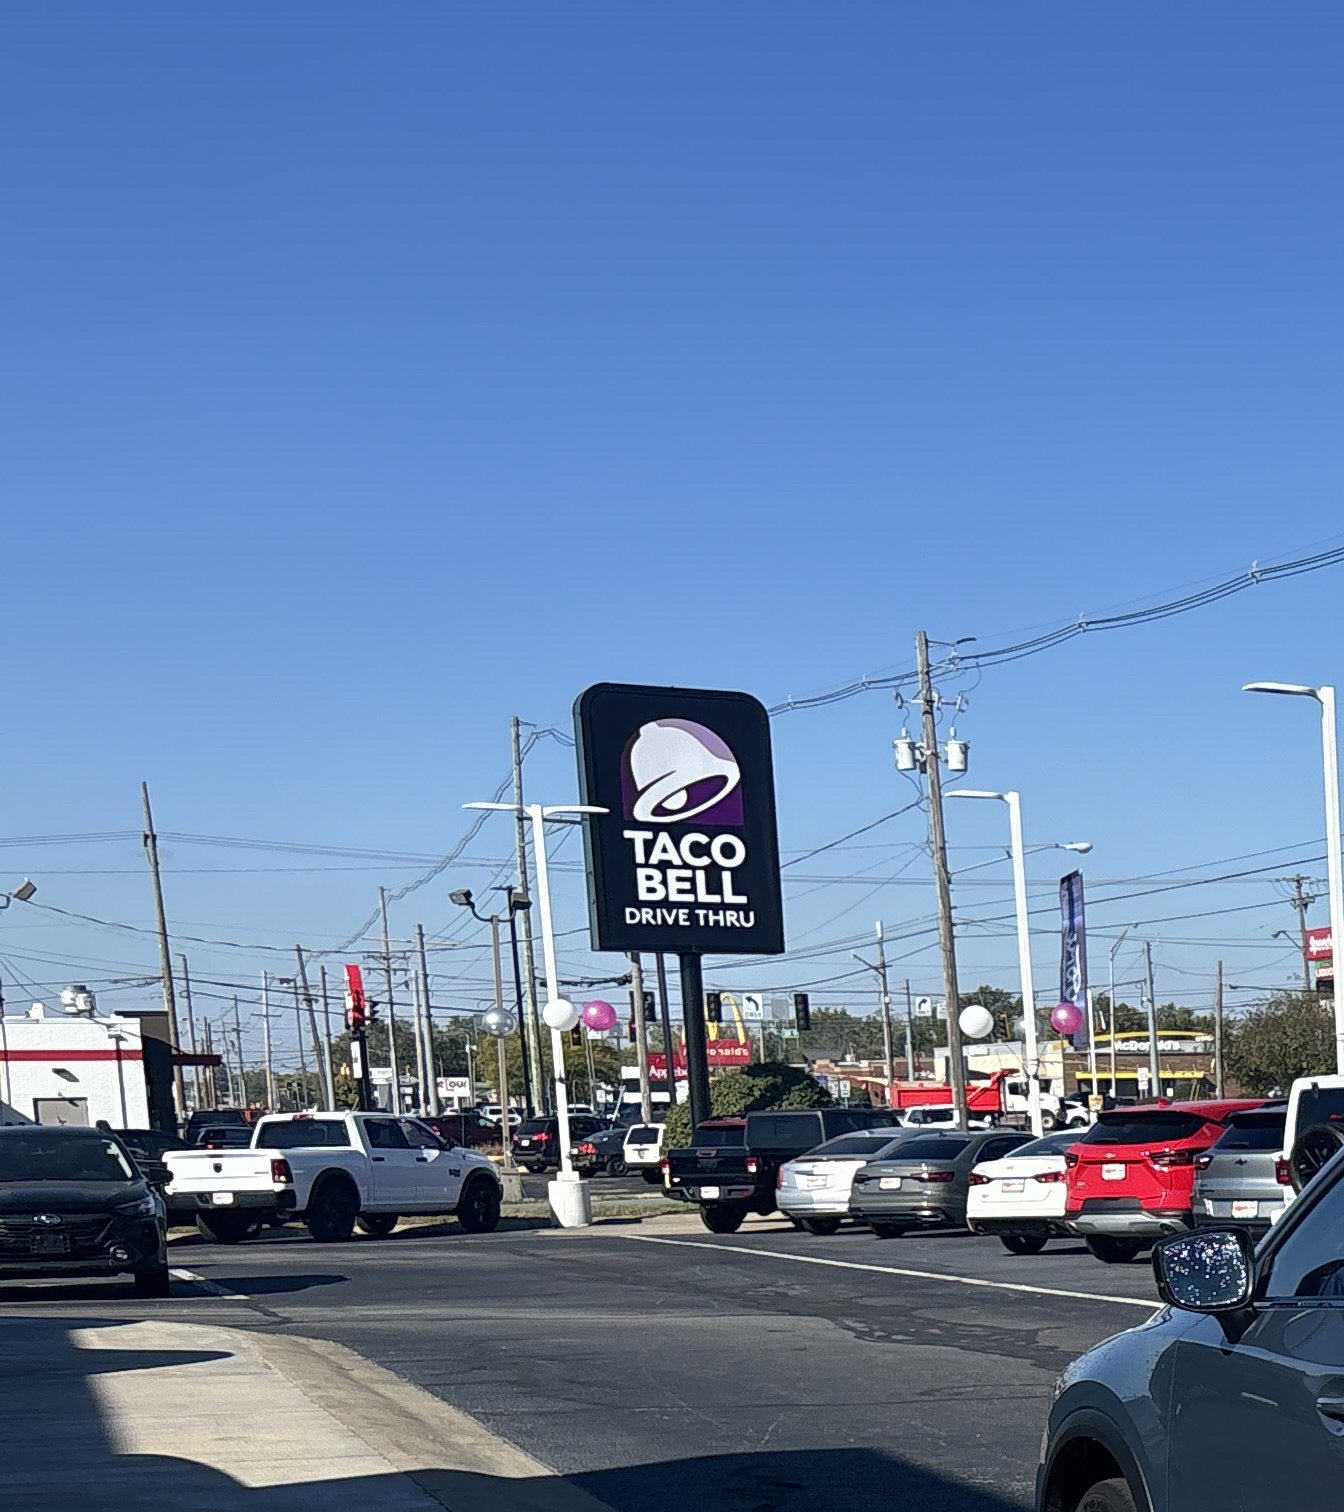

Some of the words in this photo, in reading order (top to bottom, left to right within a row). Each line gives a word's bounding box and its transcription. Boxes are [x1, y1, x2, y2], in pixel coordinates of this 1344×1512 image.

[623, 830, 746, 868] TACO
[636, 867, 748, 904] BELL
[625, 907, 691, 926] DRIVE
[694, 909, 755, 928] THRU
